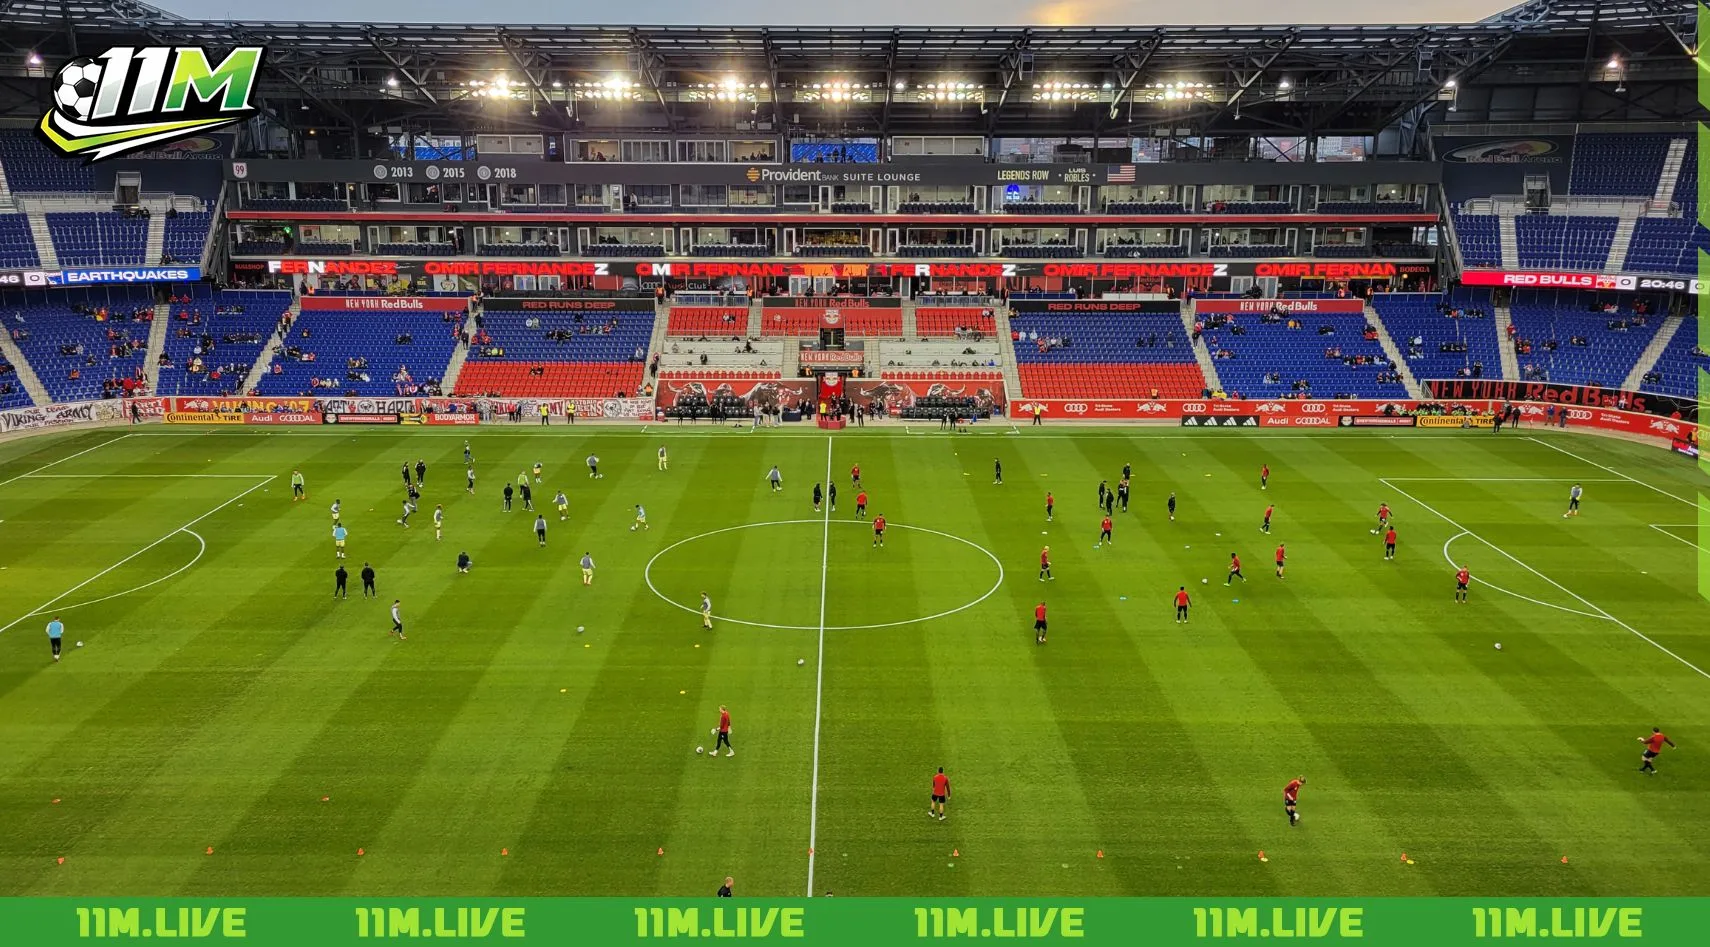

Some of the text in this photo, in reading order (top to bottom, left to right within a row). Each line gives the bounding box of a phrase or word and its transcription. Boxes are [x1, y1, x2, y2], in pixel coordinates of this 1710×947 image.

[235, 165, 245, 175] 99
[391, 167, 413, 178] 2013
[443, 168, 465, 178] 2015
[494, 168, 517, 179] 2018
[761, 168, 822, 181] Provident
[843, 173, 873, 181] SUITE
[877, 173, 921, 181] LOUNGE
[997, 170, 1049, 180] LEGENDS ROW
[1064, 173, 1090, 182] ROBLES
[268, 261, 397, 274] FERNANDEZ
[425, 262, 609, 275] OMIR FERNANDEZ
[635, 263, 690, 276] OMIR
[891, 263, 1017, 276] FERNANDEZ
[1043, 264, 1228, 276] OMIR FERNANDEZ
[1255, 264, 1311, 277] OMIR
[67, 270, 189, 282] EARTHQUAKES
[1503, 274, 1538, 285] RED
[1539, 275, 1593, 286] BULLS
[1639, 278, 1685, 290] 20:46
[345, 299, 360, 309] NEW
[361, 299, 380, 309] YORK
[1048, 303, 1073, 311] RED
[1074, 303, 1108, 311] RUNS
[1240, 301, 1254, 311] NEW
[1256, 301, 1274, 311] YORK
[801, 353, 814, 362] NEW
[815, 353, 830, 362] YORK
[1431, 381, 1464, 399] NEW
[1472, 381, 1517, 400] YORK
[1, 413, 46, 429] VIKING
[56, 404, 93, 420] ARMY
[166, 412, 214, 422] Continental
[435, 413, 475, 421] BODYARMOR
